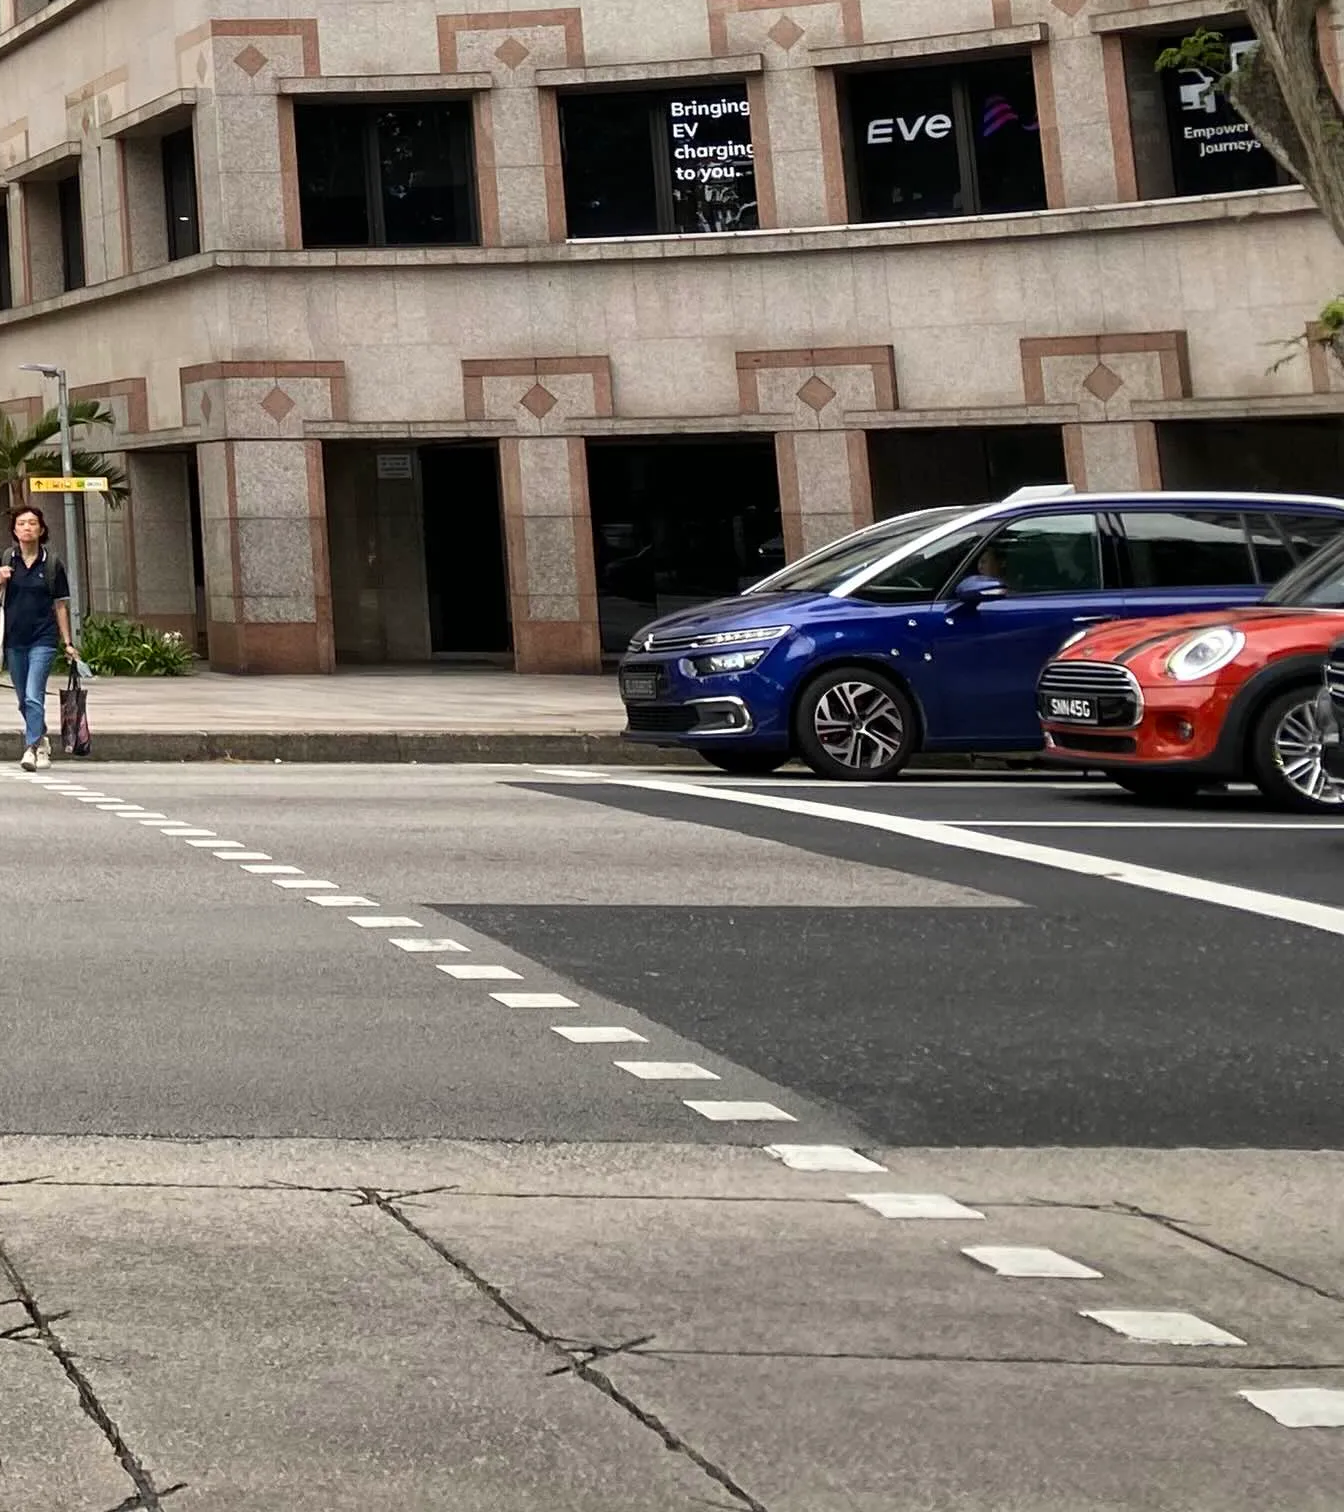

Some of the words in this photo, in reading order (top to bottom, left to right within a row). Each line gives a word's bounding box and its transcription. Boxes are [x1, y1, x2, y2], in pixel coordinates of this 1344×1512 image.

[671, 98, 750, 118] Bringing
[673, 122, 699, 138] EV
[1184, 123, 1250, 140] Empower
[674, 140, 755, 160] charging
[1200, 139, 1262, 157] Journeys
[675, 167, 696, 180] to
[700, 166, 741, 183] you.
